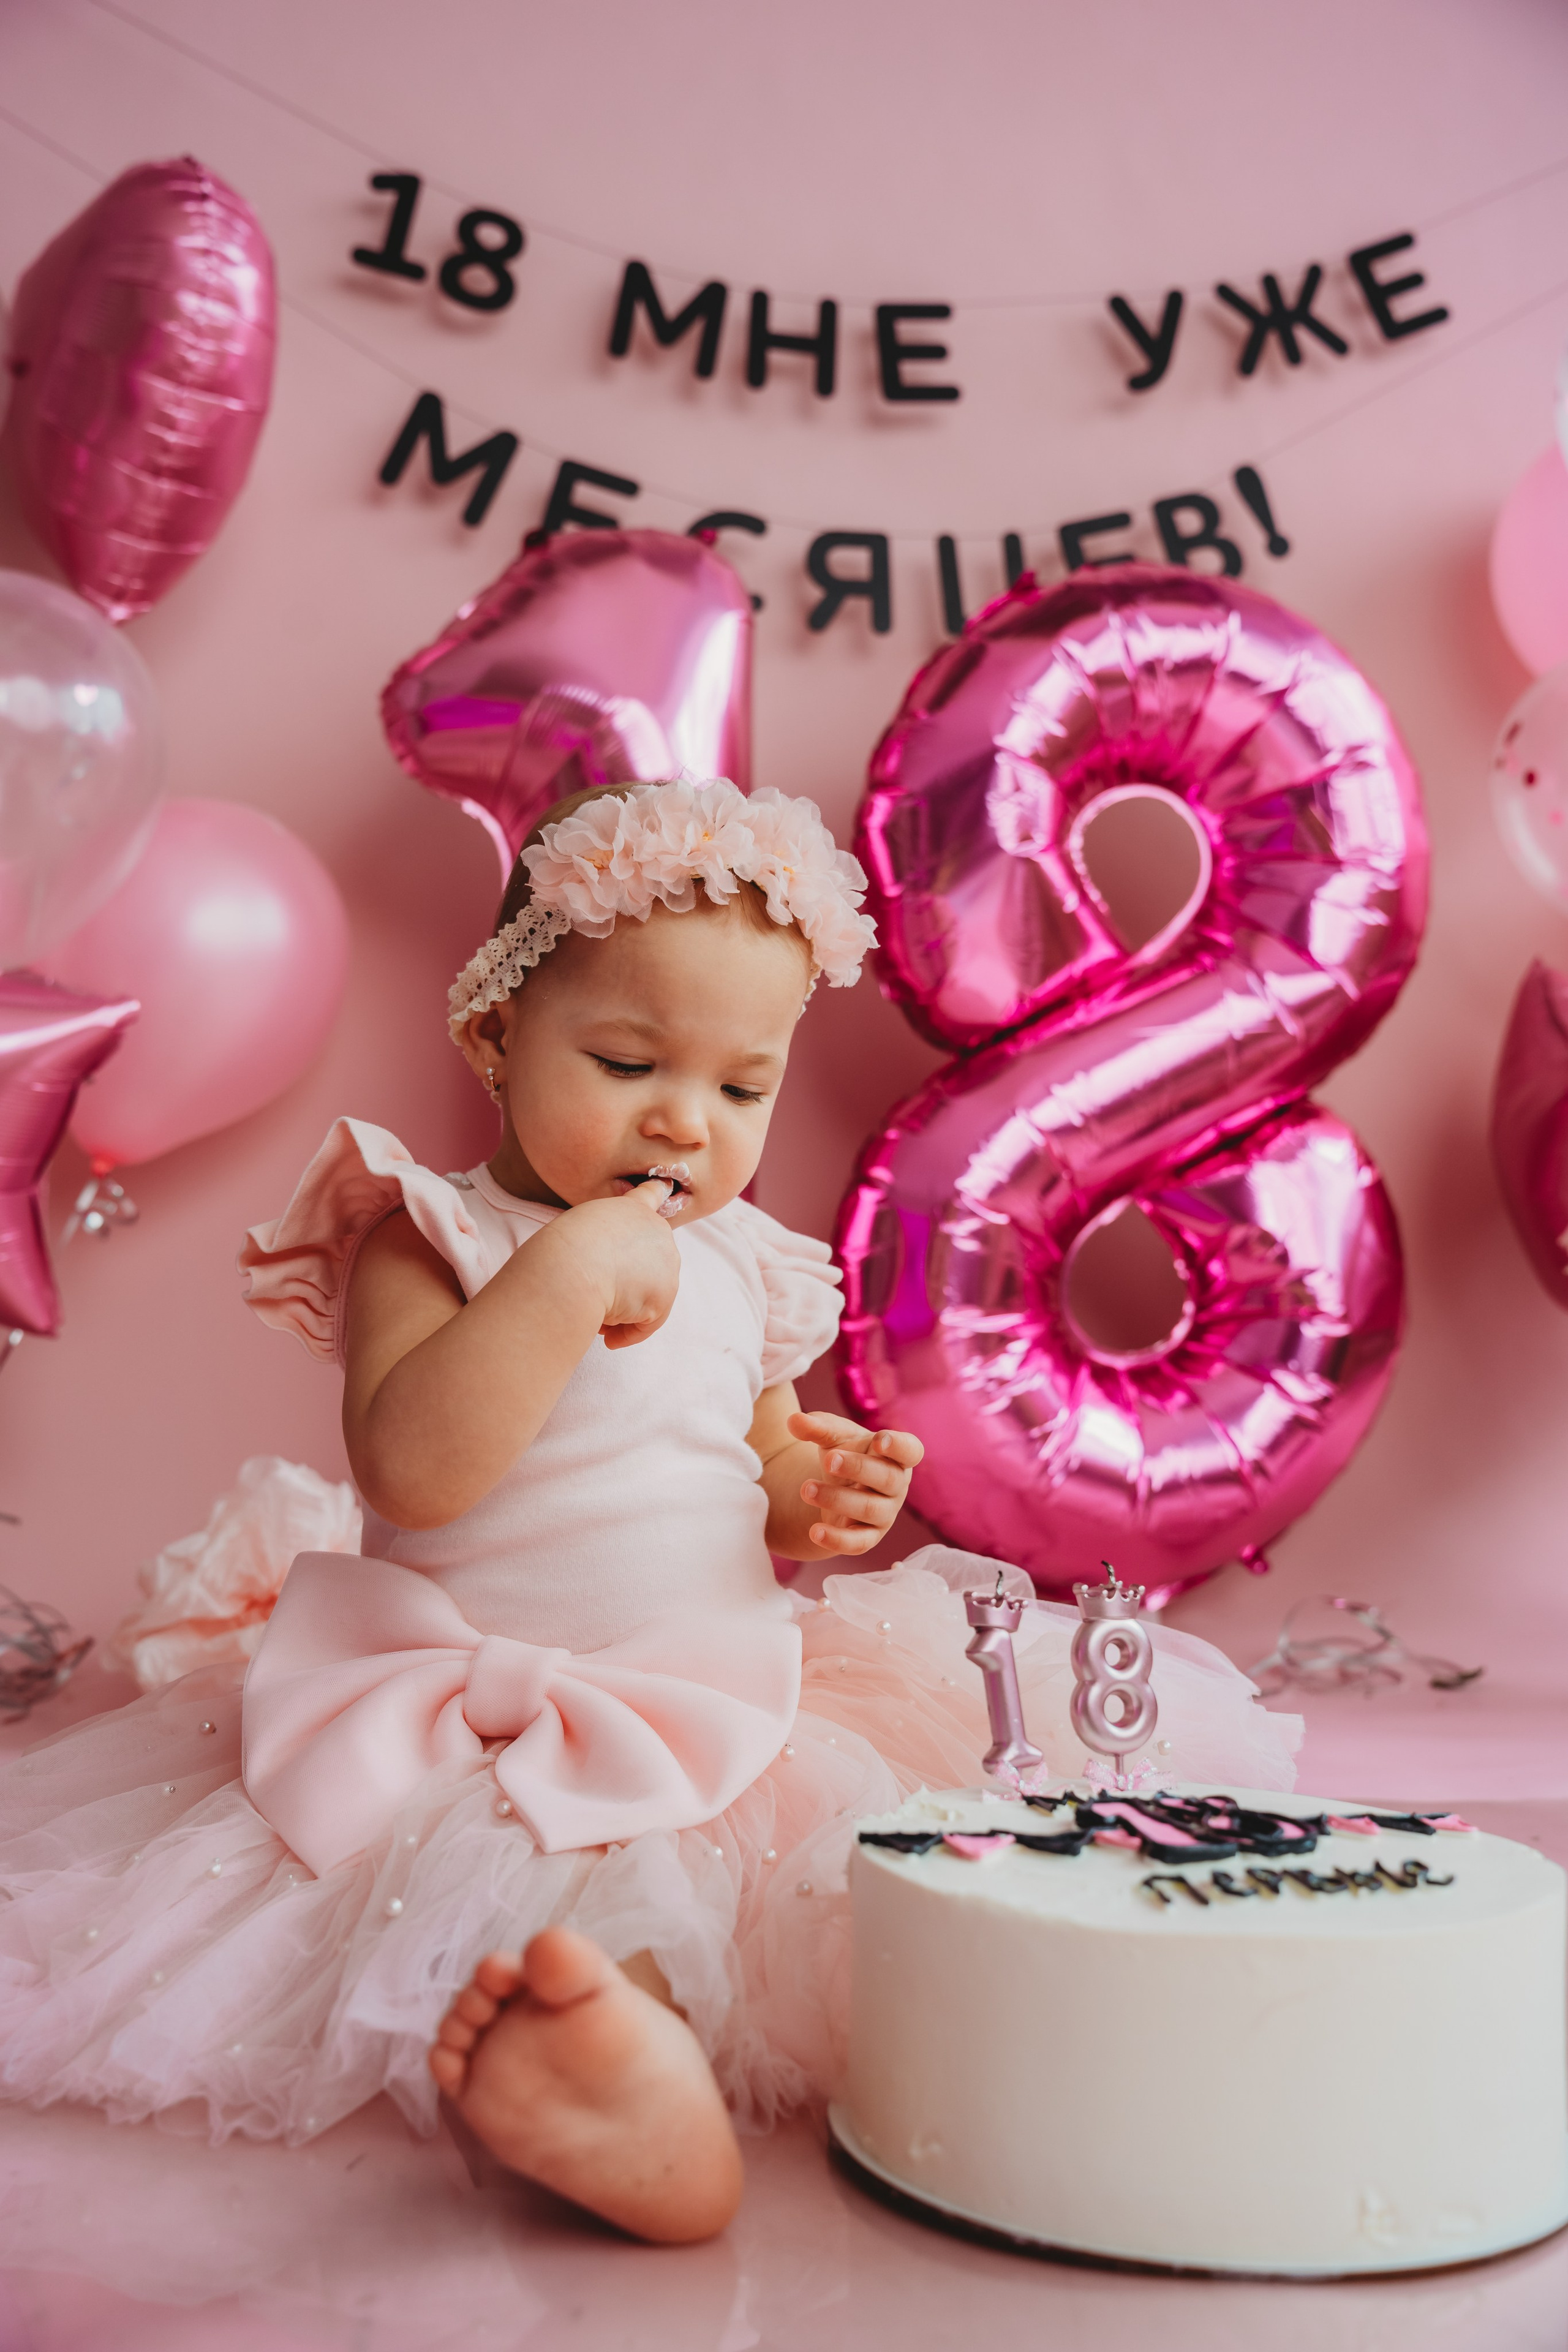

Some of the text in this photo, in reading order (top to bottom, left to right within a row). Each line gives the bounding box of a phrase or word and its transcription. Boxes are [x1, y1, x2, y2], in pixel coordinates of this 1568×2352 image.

[351, 172, 1450, 404] 18 МНЕ УЖЕ
[965, 1617, 1159, 1775] 18
